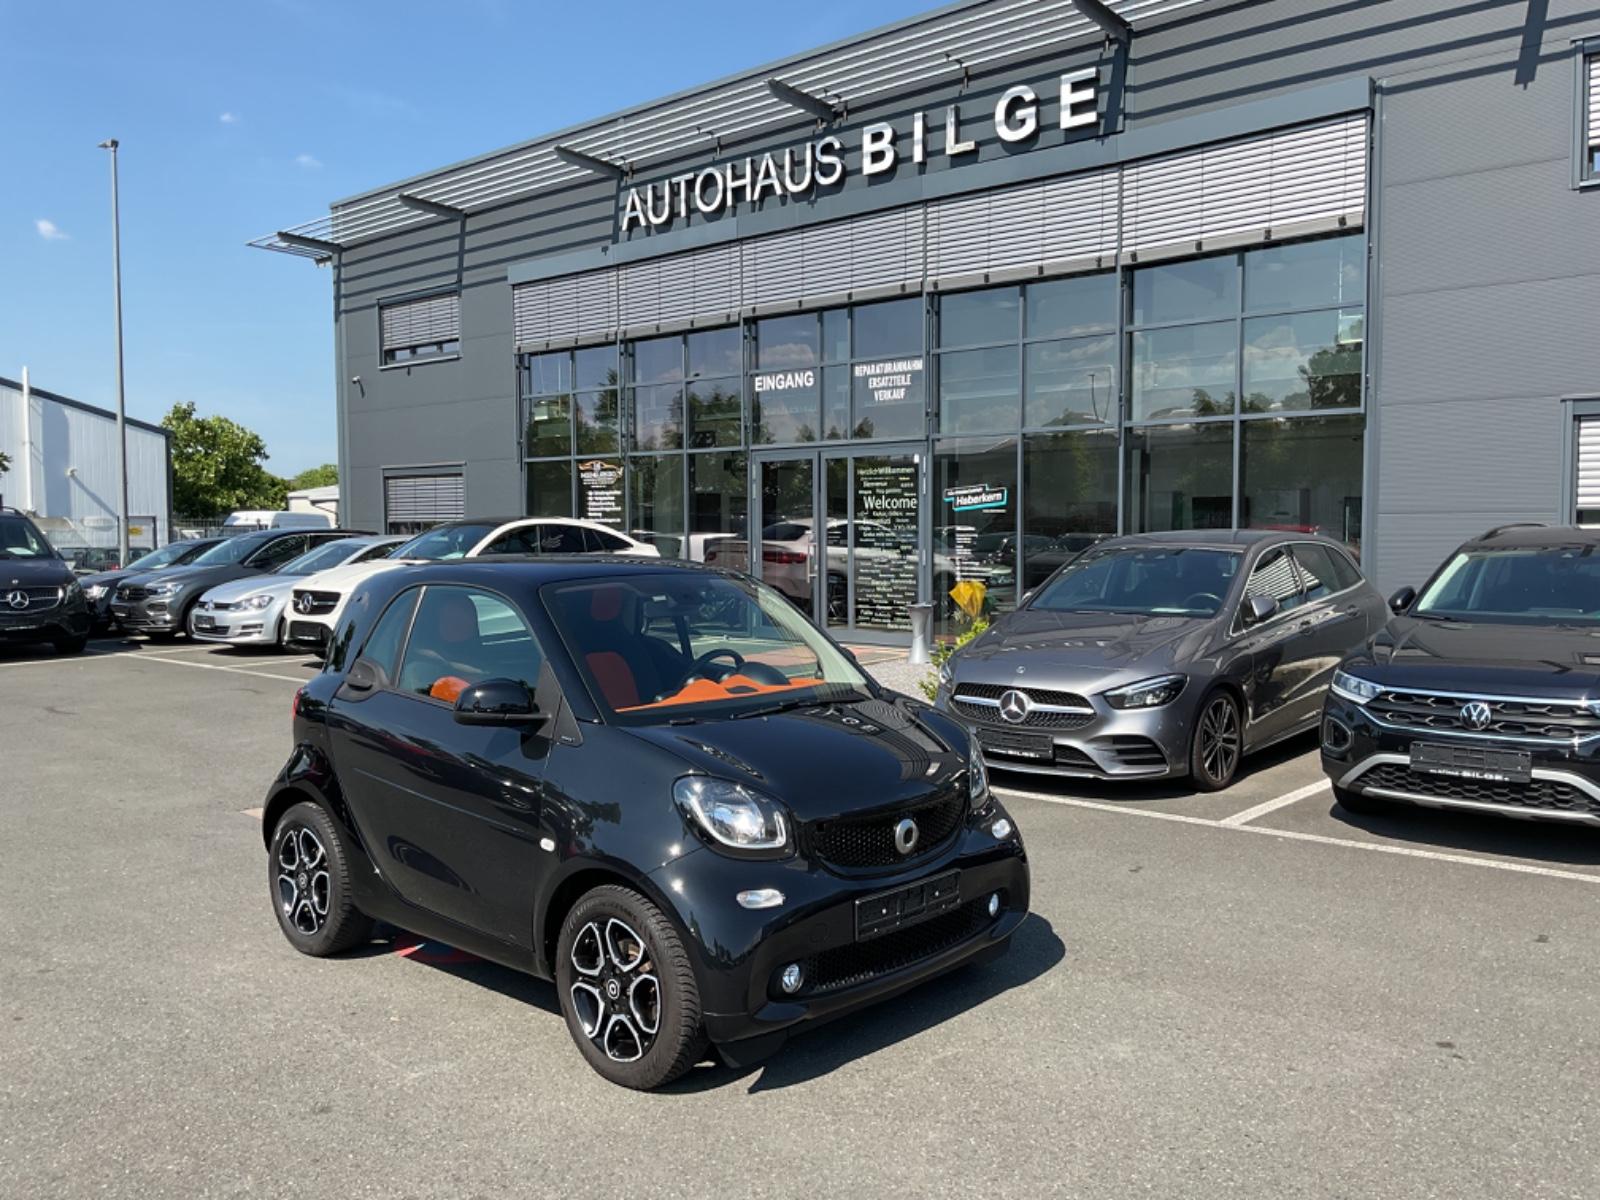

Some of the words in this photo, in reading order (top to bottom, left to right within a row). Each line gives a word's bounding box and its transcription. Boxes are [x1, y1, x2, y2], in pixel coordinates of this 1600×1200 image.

[621, 136, 843, 231] AUTOHAUS
[862, 67, 1099, 176] BILGE
[854, 359, 923, 377] REPARATURANNAHM
[754, 370, 815, 392] EINGANG
[868, 374, 912, 389] ERSATZTEILE
[873, 388, 906, 402] VERKAUF
[863, 494, 918, 509] Welcome
[956, 492, 1003, 505] Haberkern
